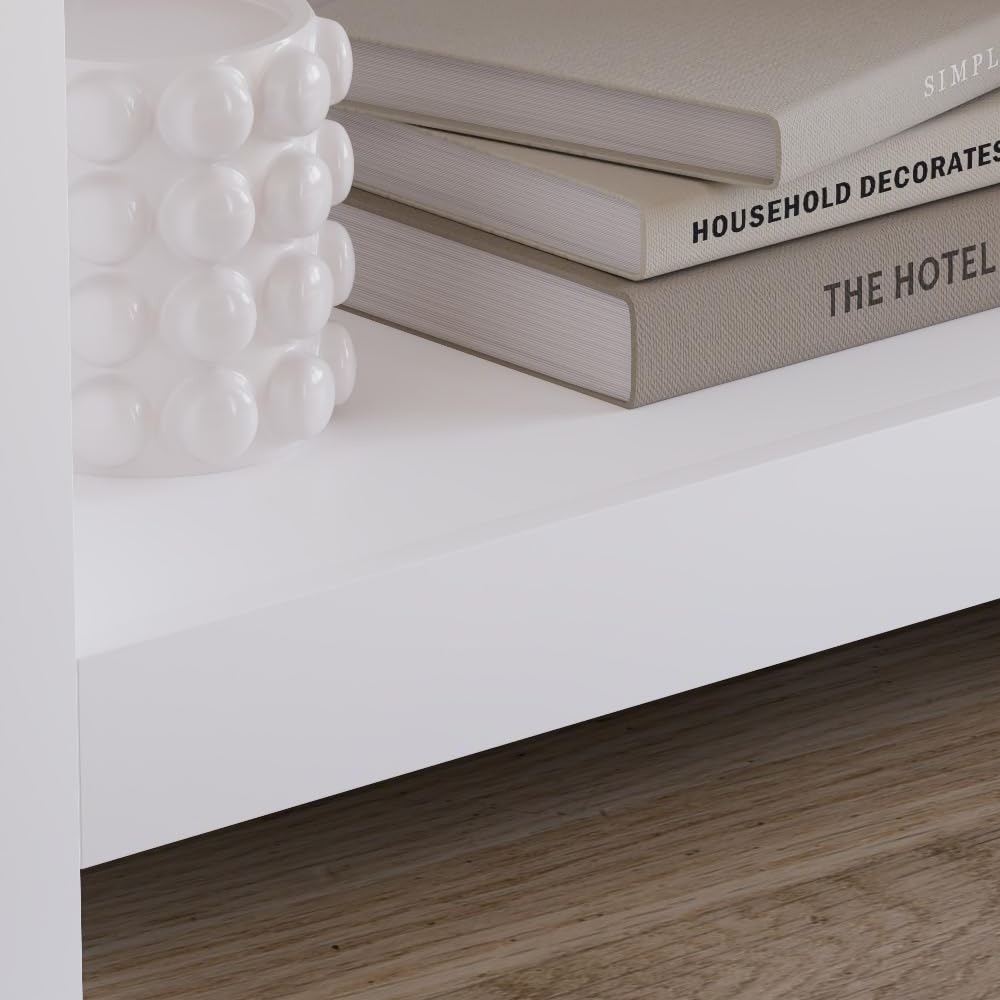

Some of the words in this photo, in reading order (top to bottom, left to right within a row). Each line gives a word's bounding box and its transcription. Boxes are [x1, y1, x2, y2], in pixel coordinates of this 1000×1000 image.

[692, 181, 851, 243] HOUSEHOLD
[823, 270, 884, 317] THE
[894, 240, 996, 300] HOTEL
